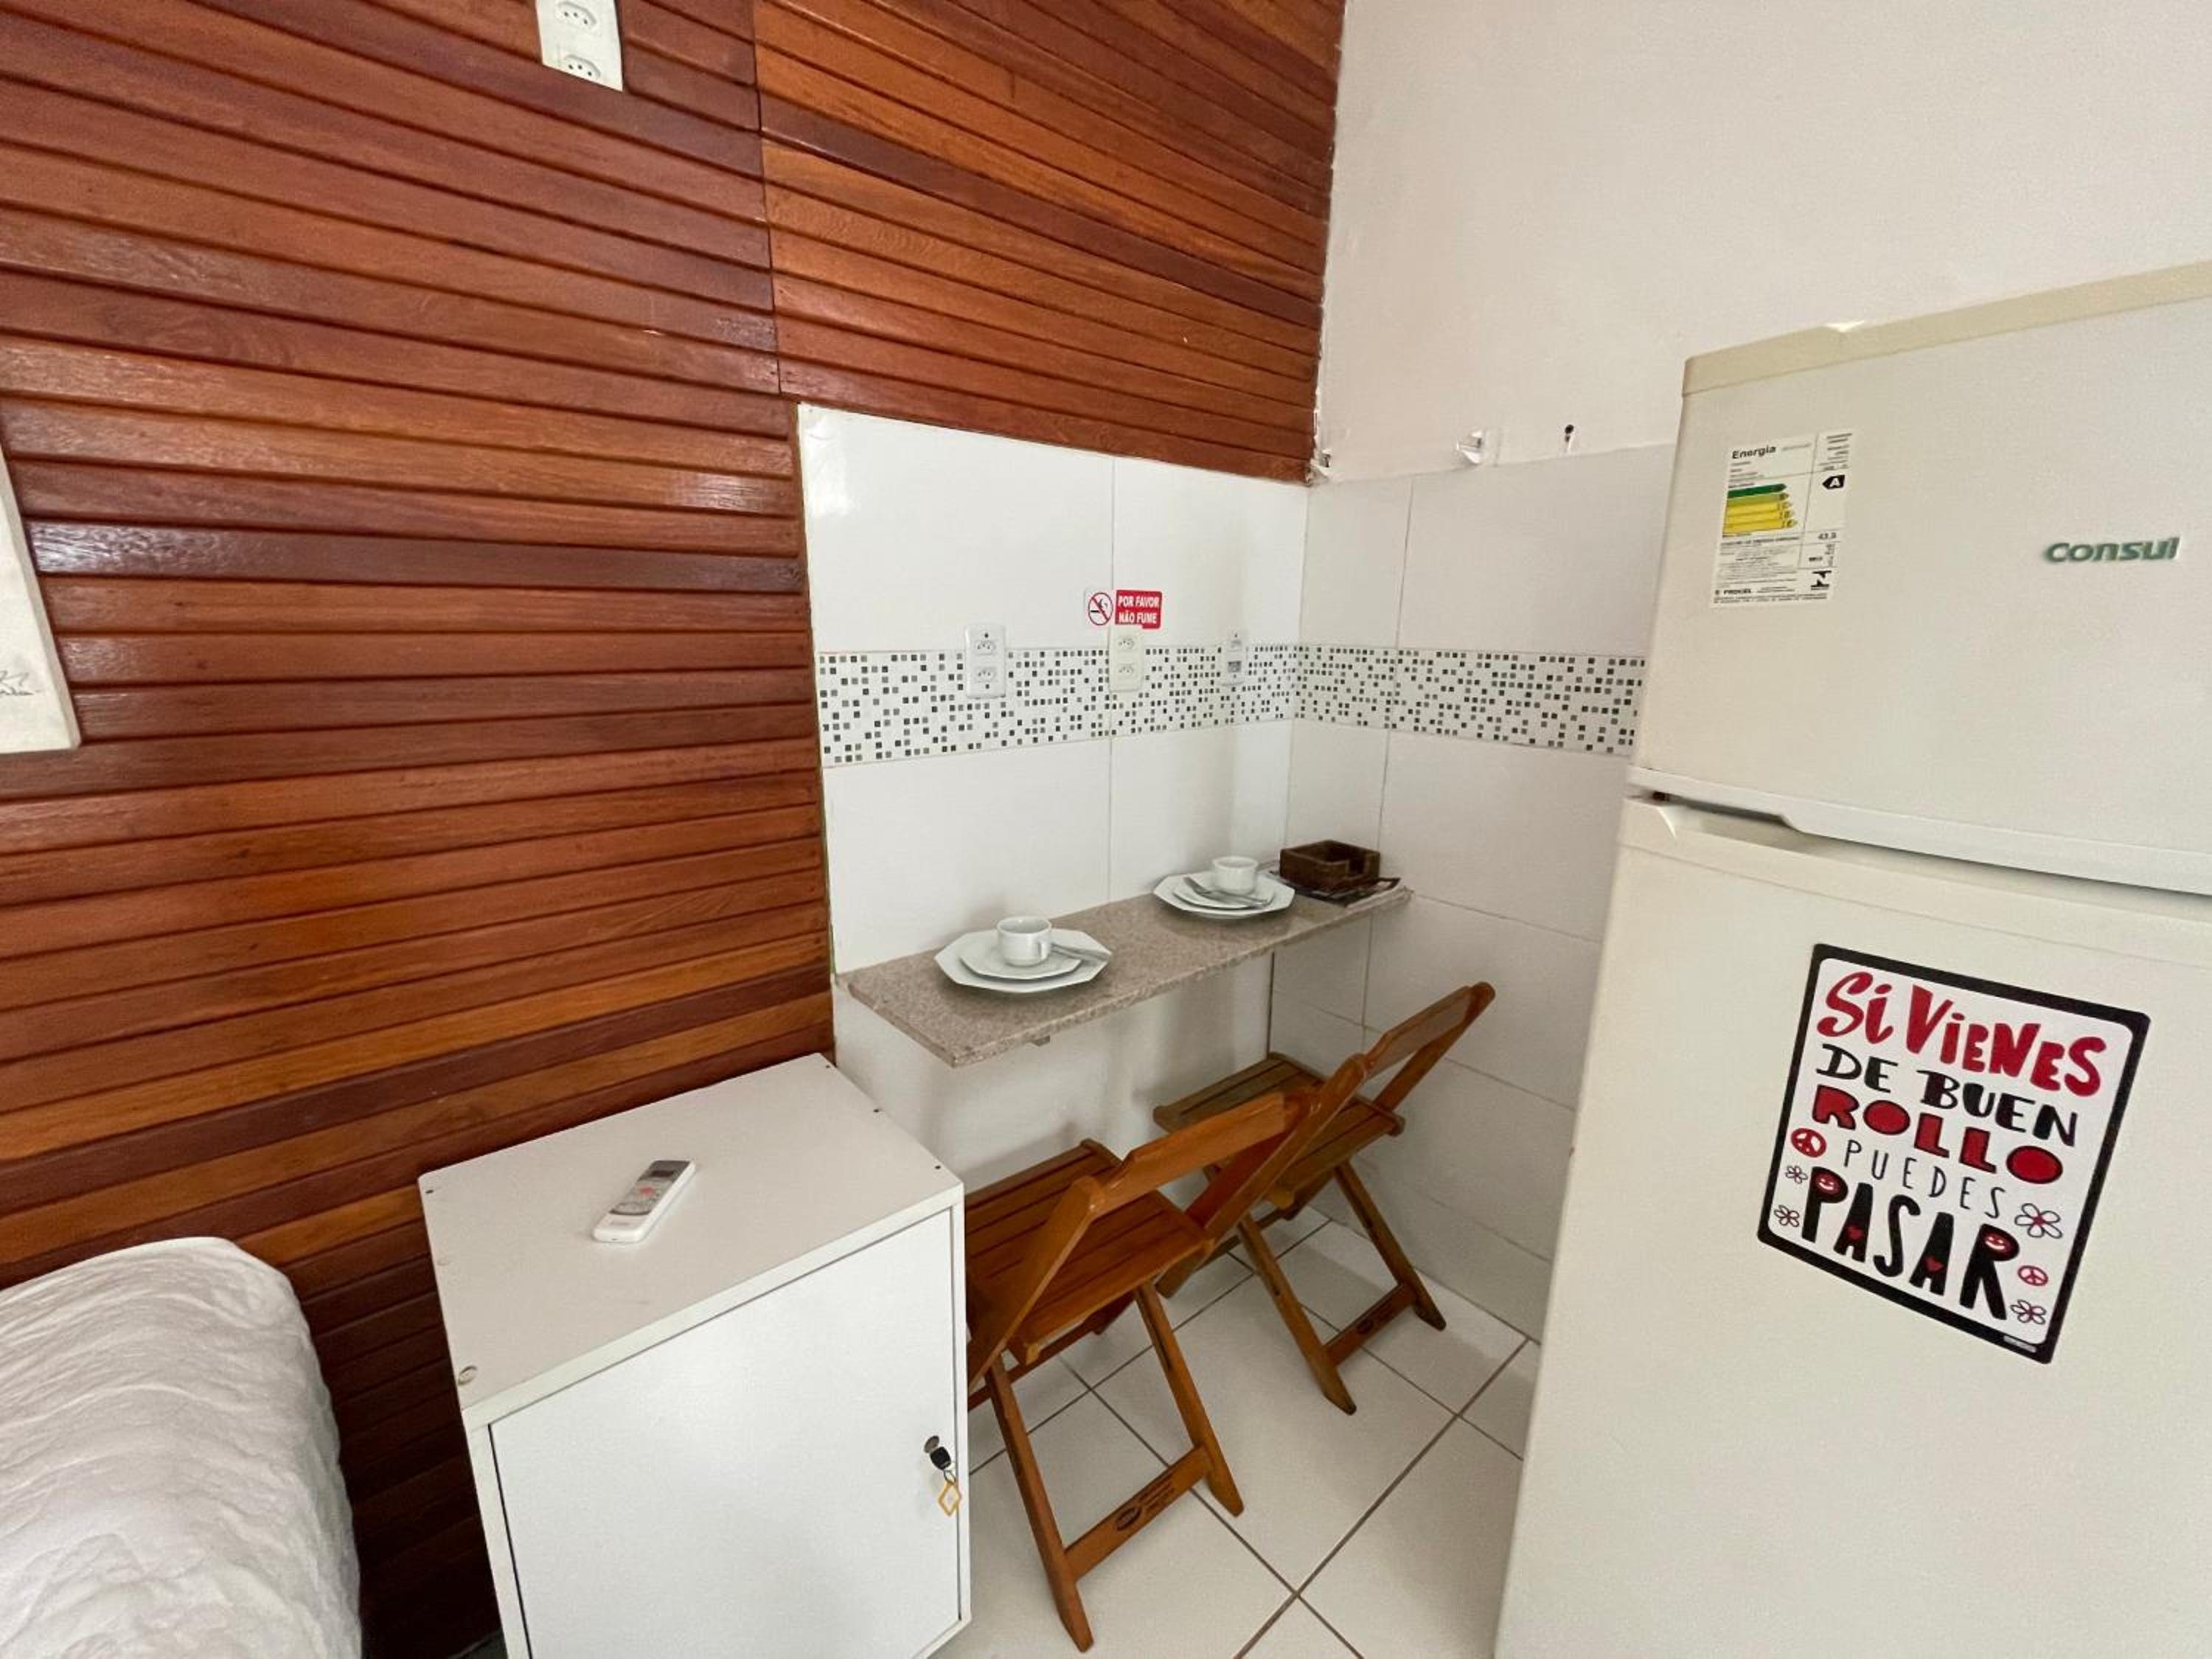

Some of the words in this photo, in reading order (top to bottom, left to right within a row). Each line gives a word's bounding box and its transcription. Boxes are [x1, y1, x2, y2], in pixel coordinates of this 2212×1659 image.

[1731, 445, 1776, 459] Energia
[1829, 478, 1840, 487] A
[2045, 536, 2180, 563] consul
[1118, 596, 1134, 608] POR
[1136, 596, 1160, 608] FAVOR
[1119, 611, 1135, 624] NÃO
[1137, 612, 1157, 624] FUME
[1815, 1043, 1899, 1093] DE
[1916, 1069, 2078, 1147] BUEN
[1812, 1085, 2064, 1185] ROLLO
[1843, 1139, 2006, 1219] PUEDES
[1801, 1166, 2020, 1321] PASAR
